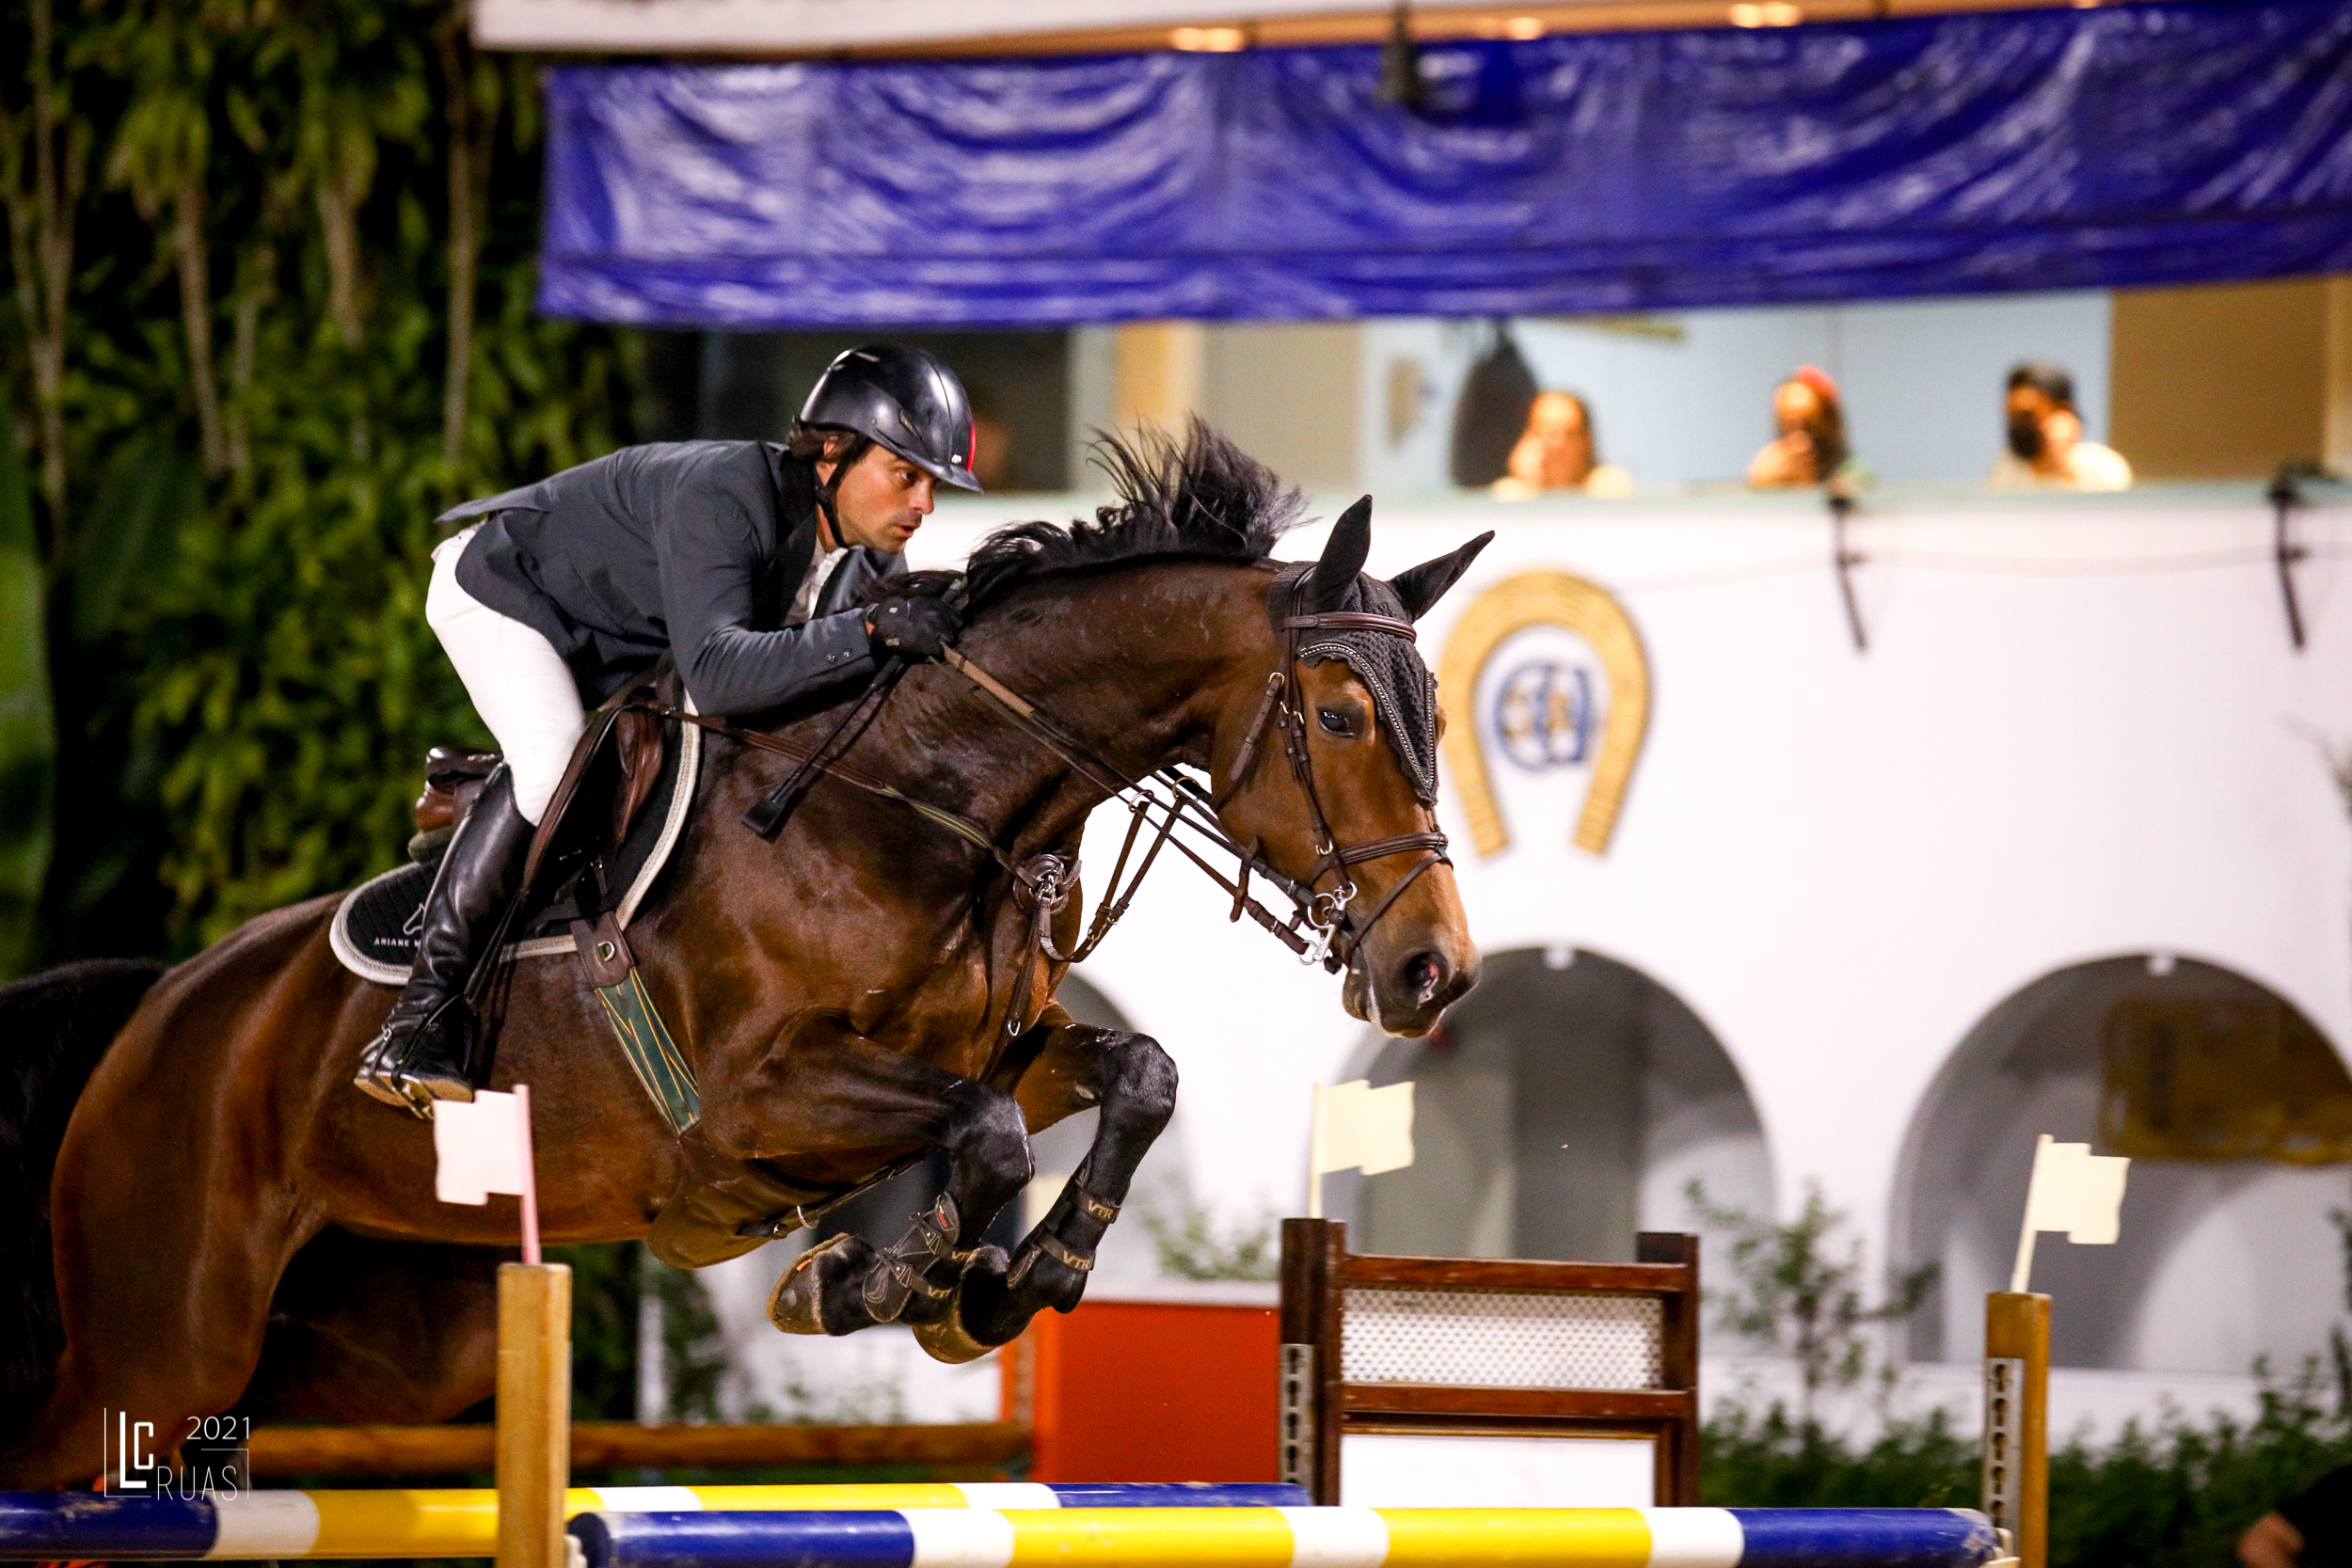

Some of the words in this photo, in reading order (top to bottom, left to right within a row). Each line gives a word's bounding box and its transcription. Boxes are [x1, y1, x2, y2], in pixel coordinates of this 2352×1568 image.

[373, 937, 409, 947] ARIANE
[1088, 1199, 1114, 1219] VTR
[1063, 1250, 1090, 1270] VTR
